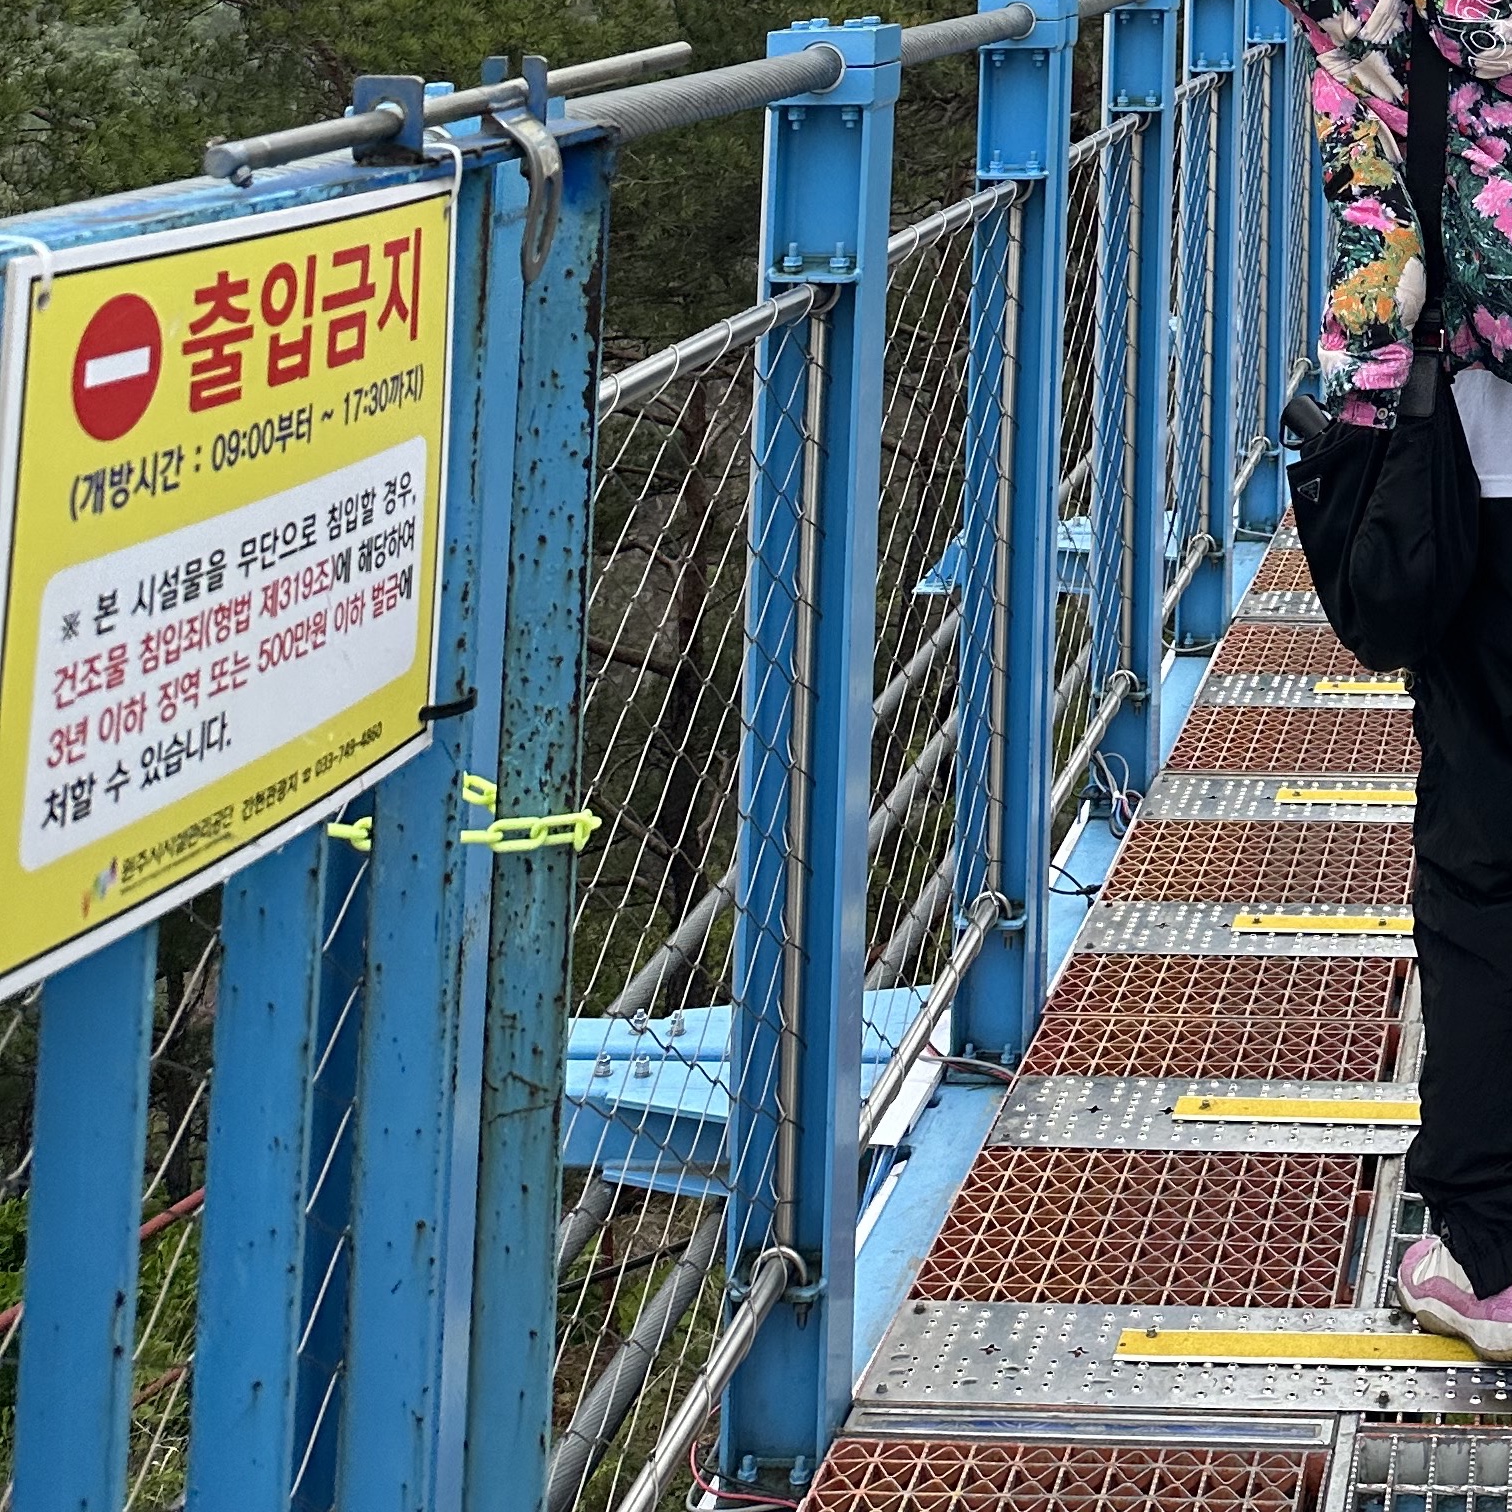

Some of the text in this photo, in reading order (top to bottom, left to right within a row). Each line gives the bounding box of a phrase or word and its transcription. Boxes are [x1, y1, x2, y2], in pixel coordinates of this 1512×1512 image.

[182, 228, 422, 413] 출입금지
[70, 445, 185, 521] (개방시간
[212, 403, 312, 471] 09:00부터
[344, 364, 424, 425] 17:30까지)
[54, 516, 415, 710] 건조물 침입죄(형법 제319조)에 해당하여
[93, 590, 118, 635] 본
[131, 549, 227, 616] 시설물을
[238, 514, 316, 577] 무단으로
[327, 487, 376, 541] 침입할
[383, 472, 415, 515] 경우,
[47, 564, 413, 768] 3년 이하 징역 또는 500만원 이하 벌금에
[42, 711, 231, 828] 처할 수 있습니다.
